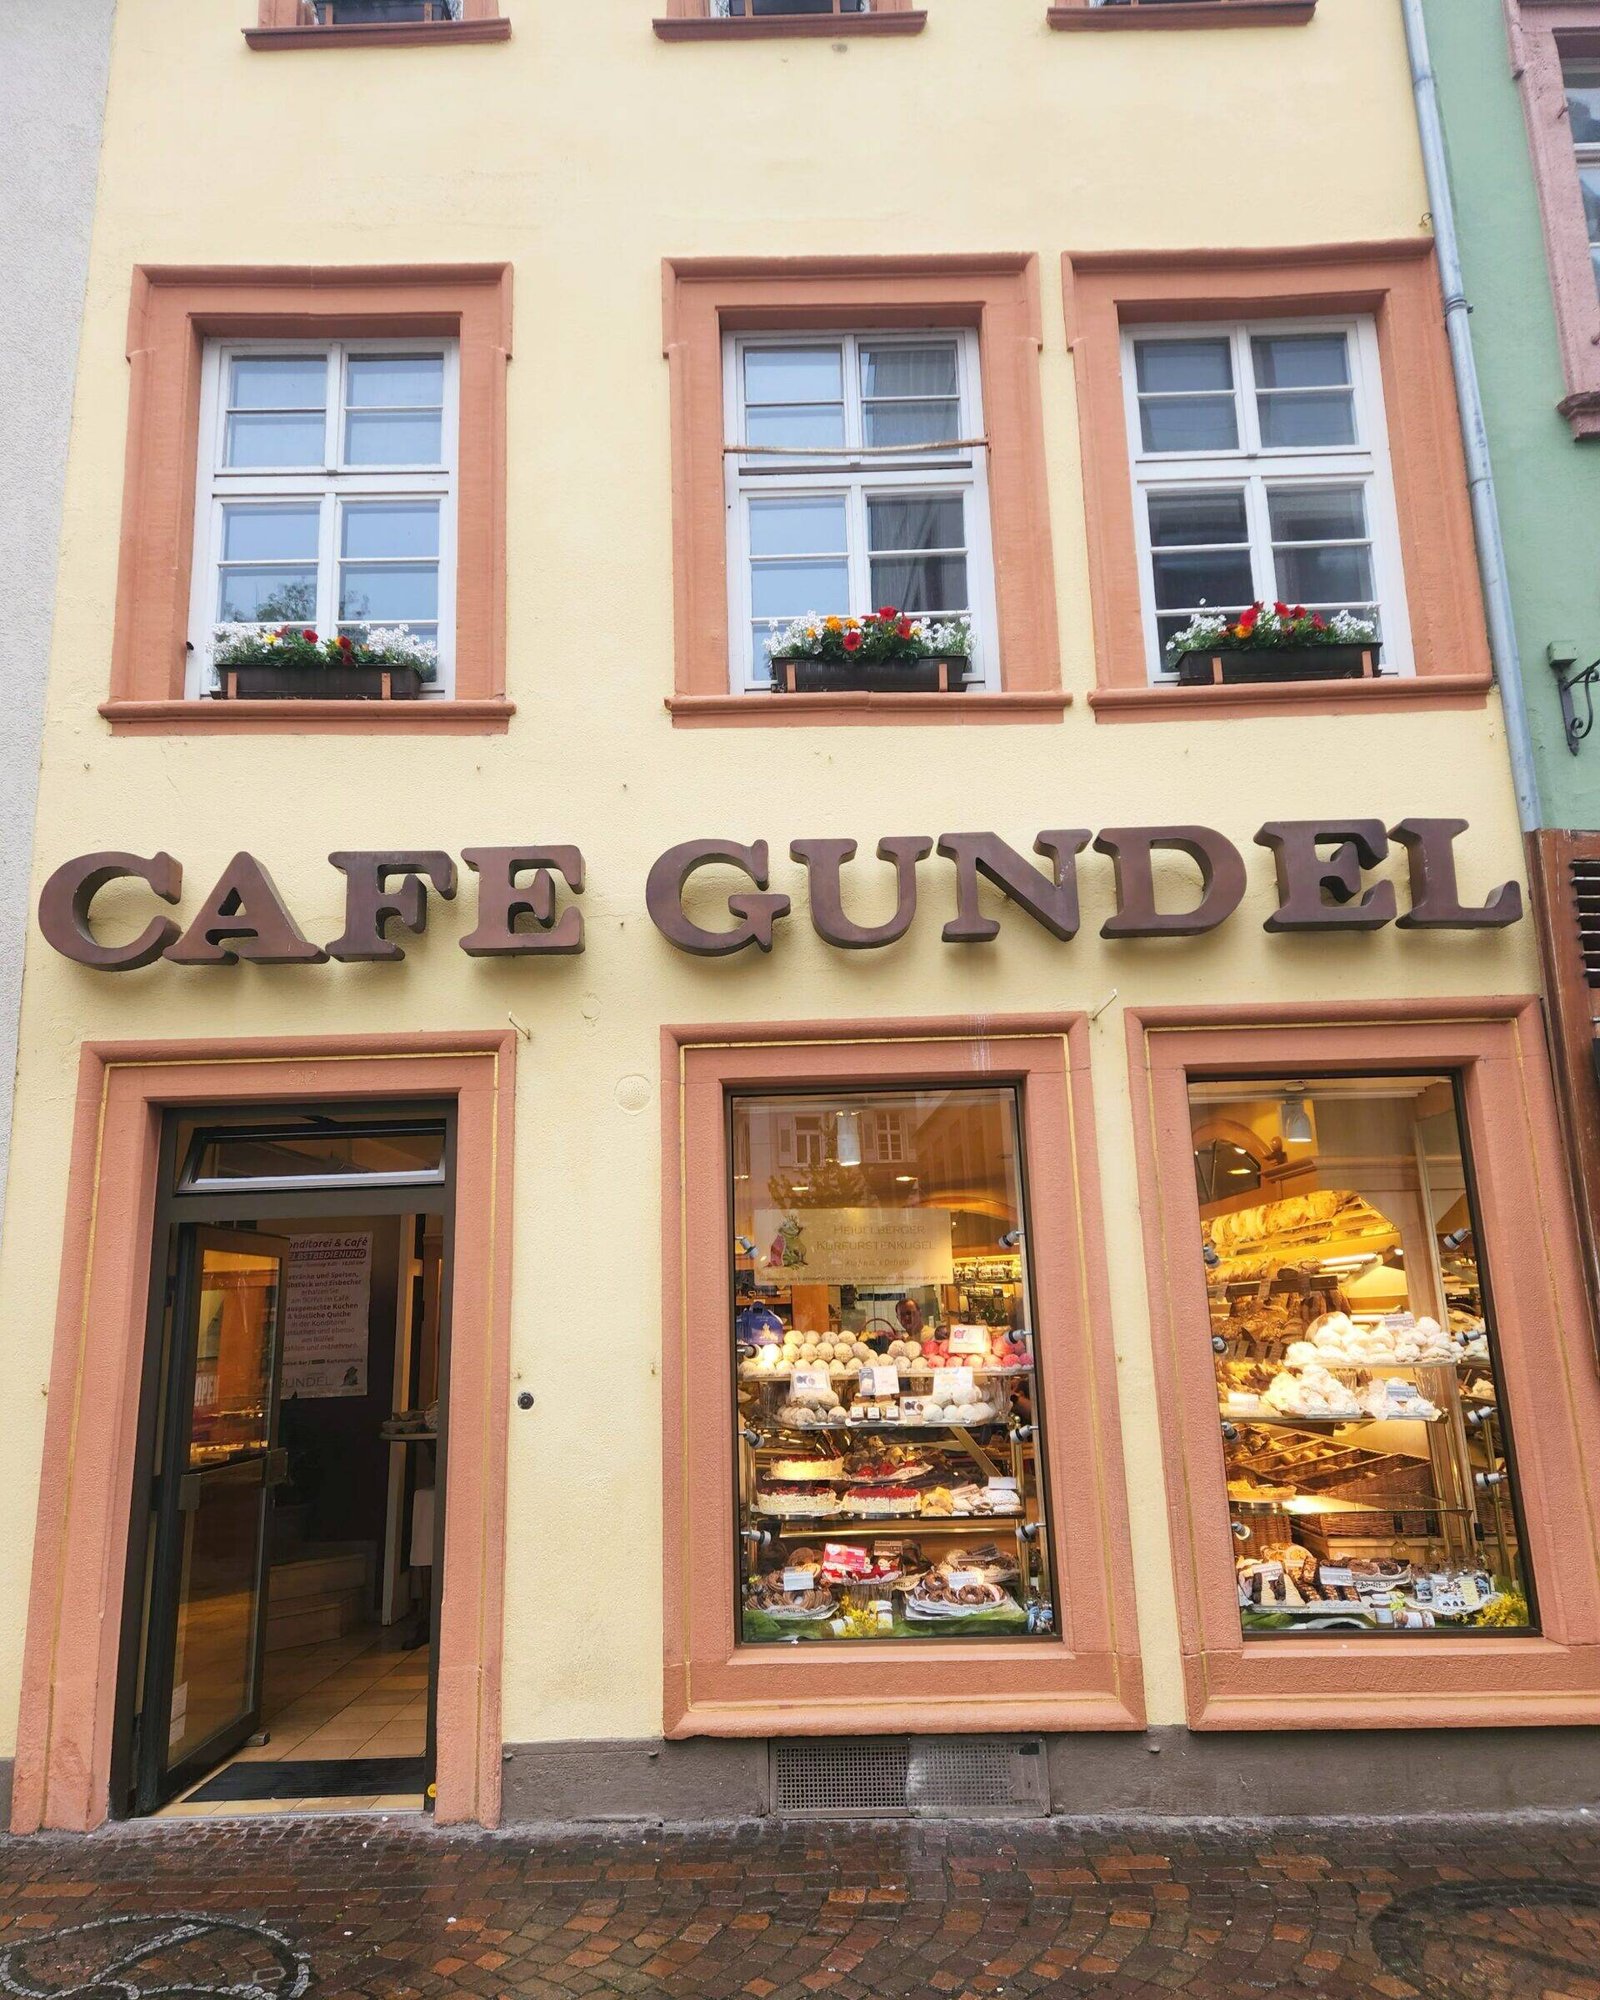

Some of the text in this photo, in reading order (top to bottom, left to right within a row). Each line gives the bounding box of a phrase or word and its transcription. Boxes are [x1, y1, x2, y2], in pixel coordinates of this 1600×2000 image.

[39, 818, 1524, 972] CAFE GUNDEL
[344, 1237, 368, 1248] Café
